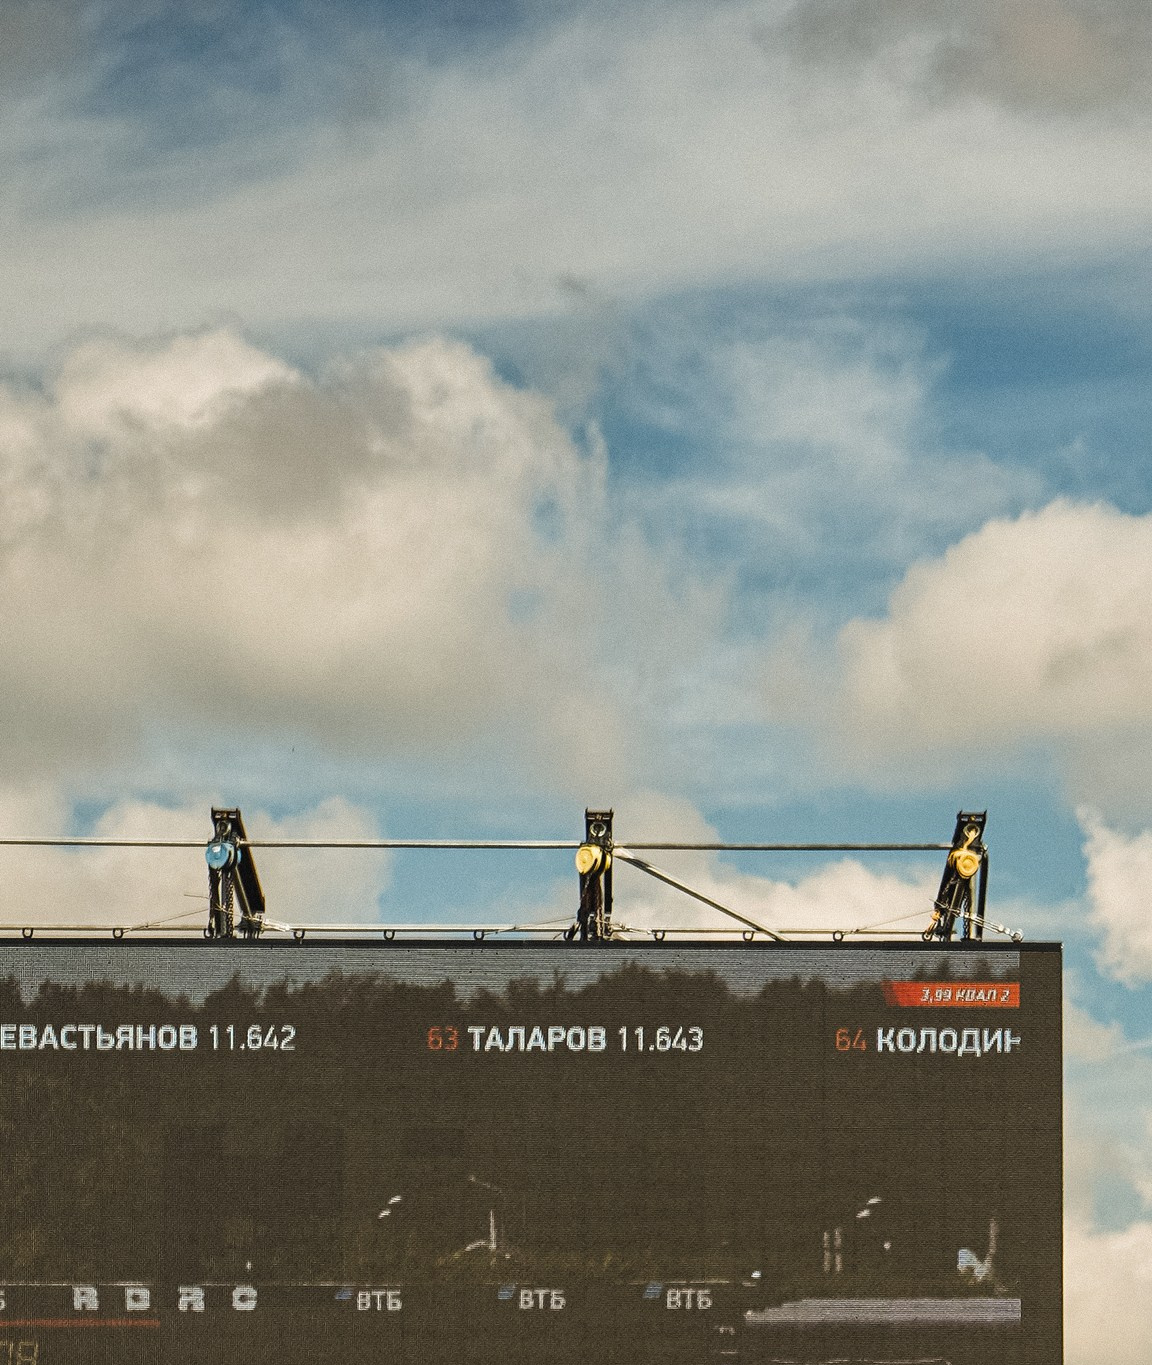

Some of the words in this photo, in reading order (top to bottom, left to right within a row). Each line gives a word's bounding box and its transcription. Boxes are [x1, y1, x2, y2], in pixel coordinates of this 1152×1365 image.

[1000, 988, 1010, 1003] 2
[0, 1024, 197, 1050] ЕВАСТЬЯНОВ
[210, 1024, 296, 1050] 11.642
[427, 1026, 459, 1051] 63
[468, 1026, 606, 1051] ТАЛАРОВ
[619, 1026, 704, 1051] 11.643
[835, 1028, 867, 1051] 64
[357, 1290, 402, 1311] ВТБ
[519, 1289, 566, 1310] ВТБ
[666, 1289, 713, 1310] ВТБ
